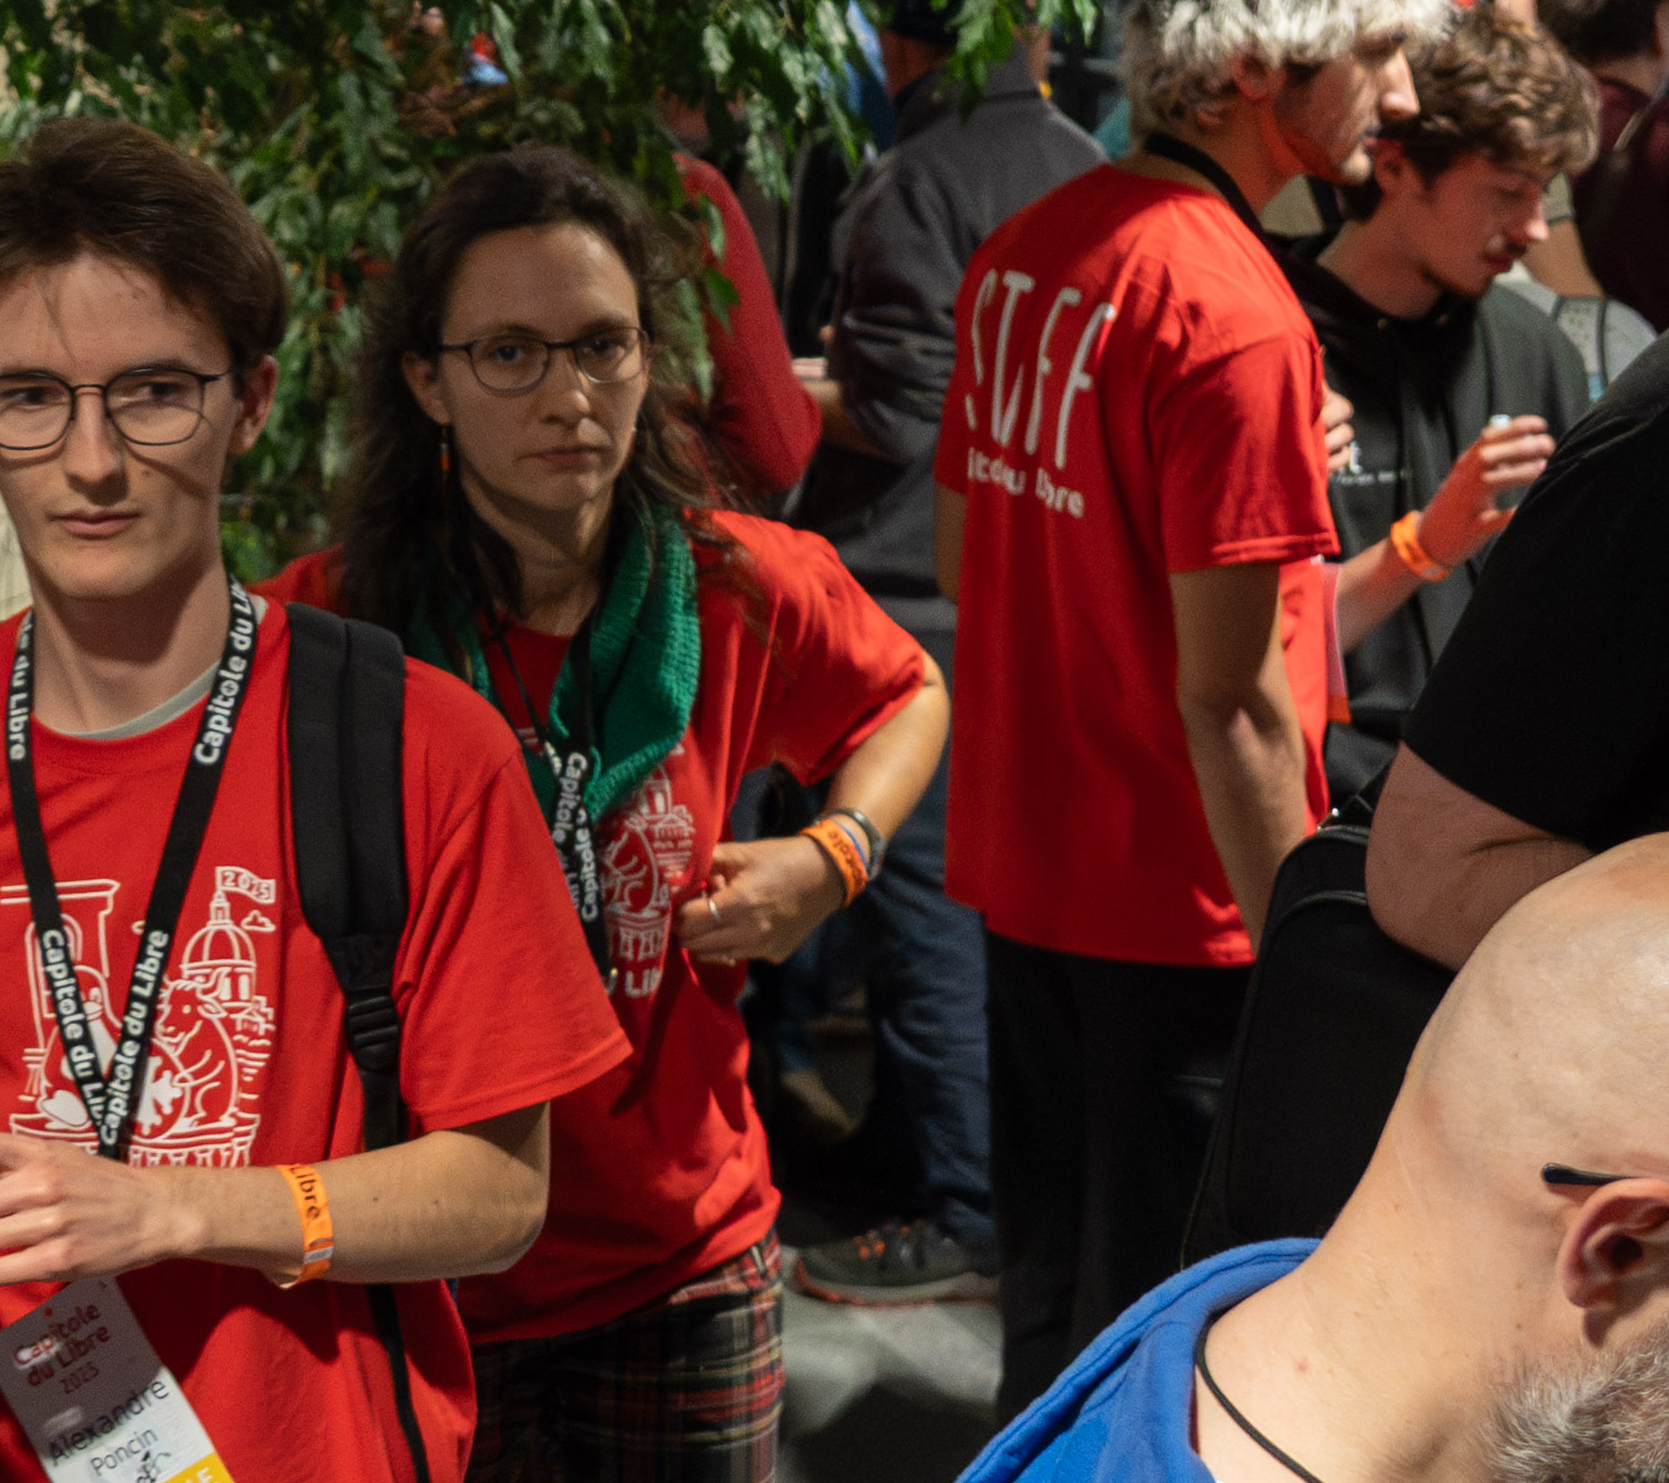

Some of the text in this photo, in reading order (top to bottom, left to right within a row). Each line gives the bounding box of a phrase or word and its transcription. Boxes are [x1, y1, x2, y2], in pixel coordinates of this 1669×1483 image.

[8, 691, 30, 761] Libre
[192, 654, 249, 765] Capitole
[229, 617, 255, 652] du
[551, 750, 588, 844] Capitole
[573, 825, 600, 922] Capitole
[41, 928, 84, 1040] Capitole
[69, 1043, 95, 1079] du
[99, 928, 170, 1147] Capitole du Libre
[288, 1166, 321, 1220] Libre
[14, 1302, 103, 1366] Capitole
[26, 1324, 112, 1388] du Libre
[48, 1377, 171, 1467] Alexandre
[89, 1426, 160, 1478] Poncin
